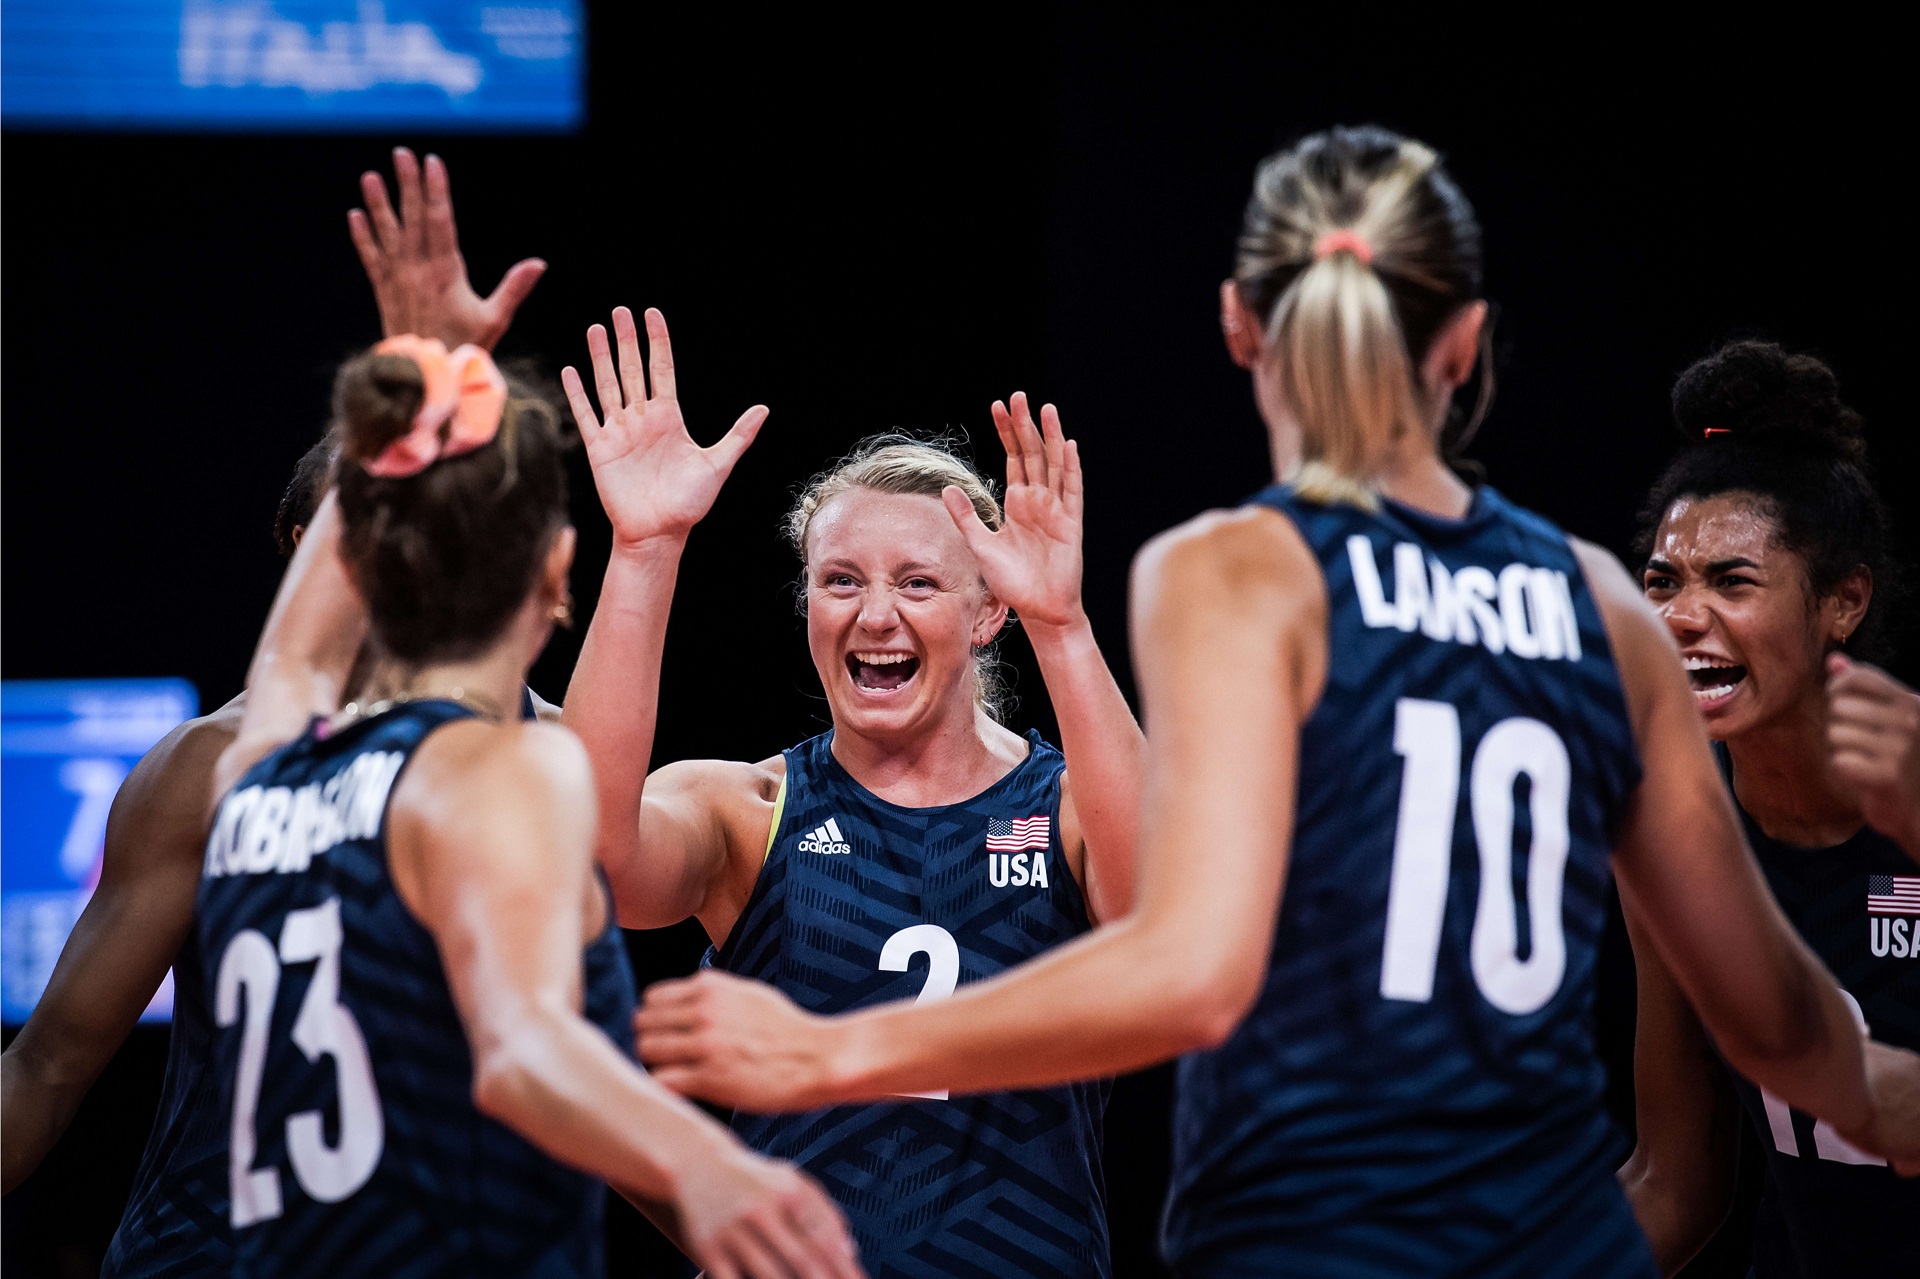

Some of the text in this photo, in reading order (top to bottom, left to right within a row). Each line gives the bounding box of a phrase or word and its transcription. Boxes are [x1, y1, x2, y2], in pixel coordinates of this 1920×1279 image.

[798, 839, 851, 854] adidas
[989, 851, 1048, 888] USA
[1380, 697, 1571, 1015] 10
[215, 897, 385, 1228] 23
